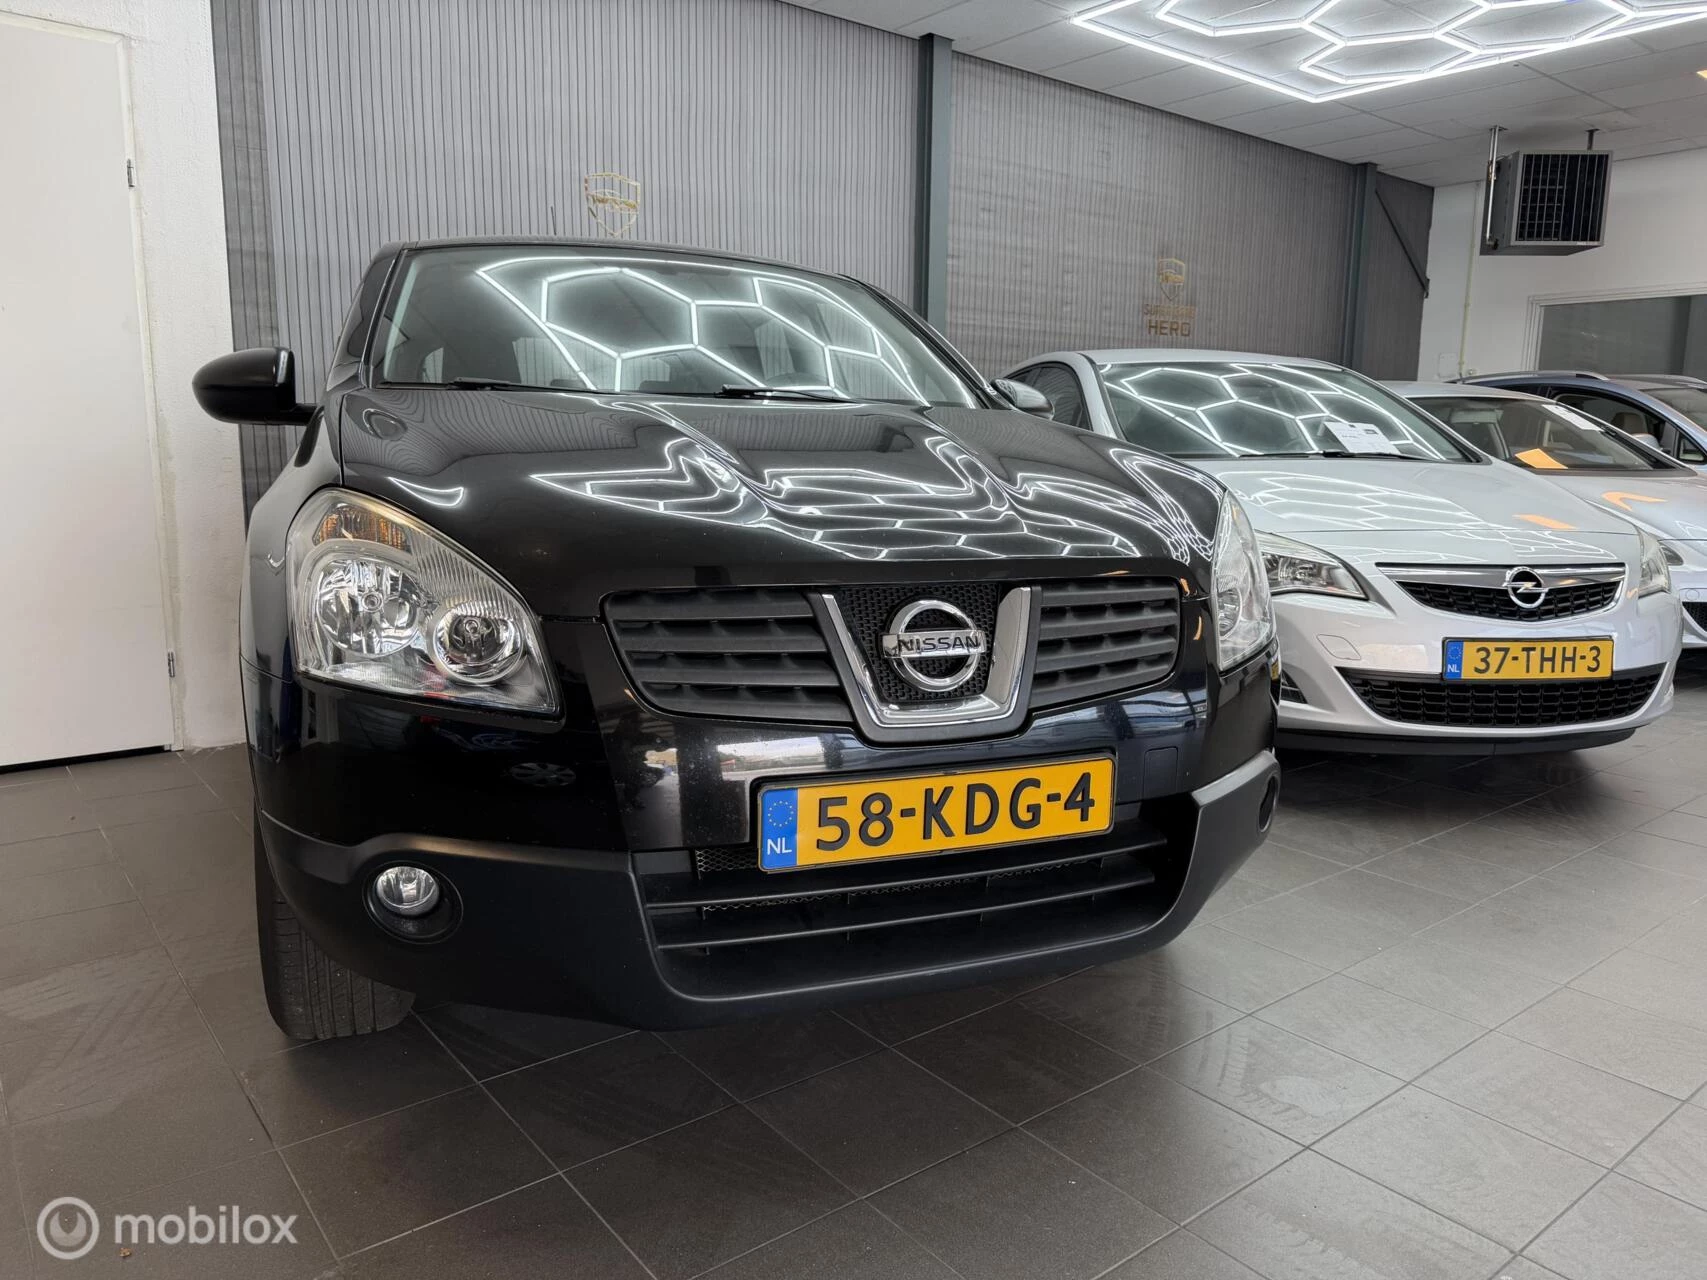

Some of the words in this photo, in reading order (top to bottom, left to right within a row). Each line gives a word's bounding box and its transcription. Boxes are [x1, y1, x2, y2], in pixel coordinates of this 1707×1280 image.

[1148, 319, 1191, 337] HERO
[899, 635, 980, 652] NISSAN
[1447, 664, 1460, 673] NL
[1473, 645, 1601, 675] 37-THH-3
[766, 837, 793, 855] NL
[816, 771, 1096, 851] 58-KDG-4
